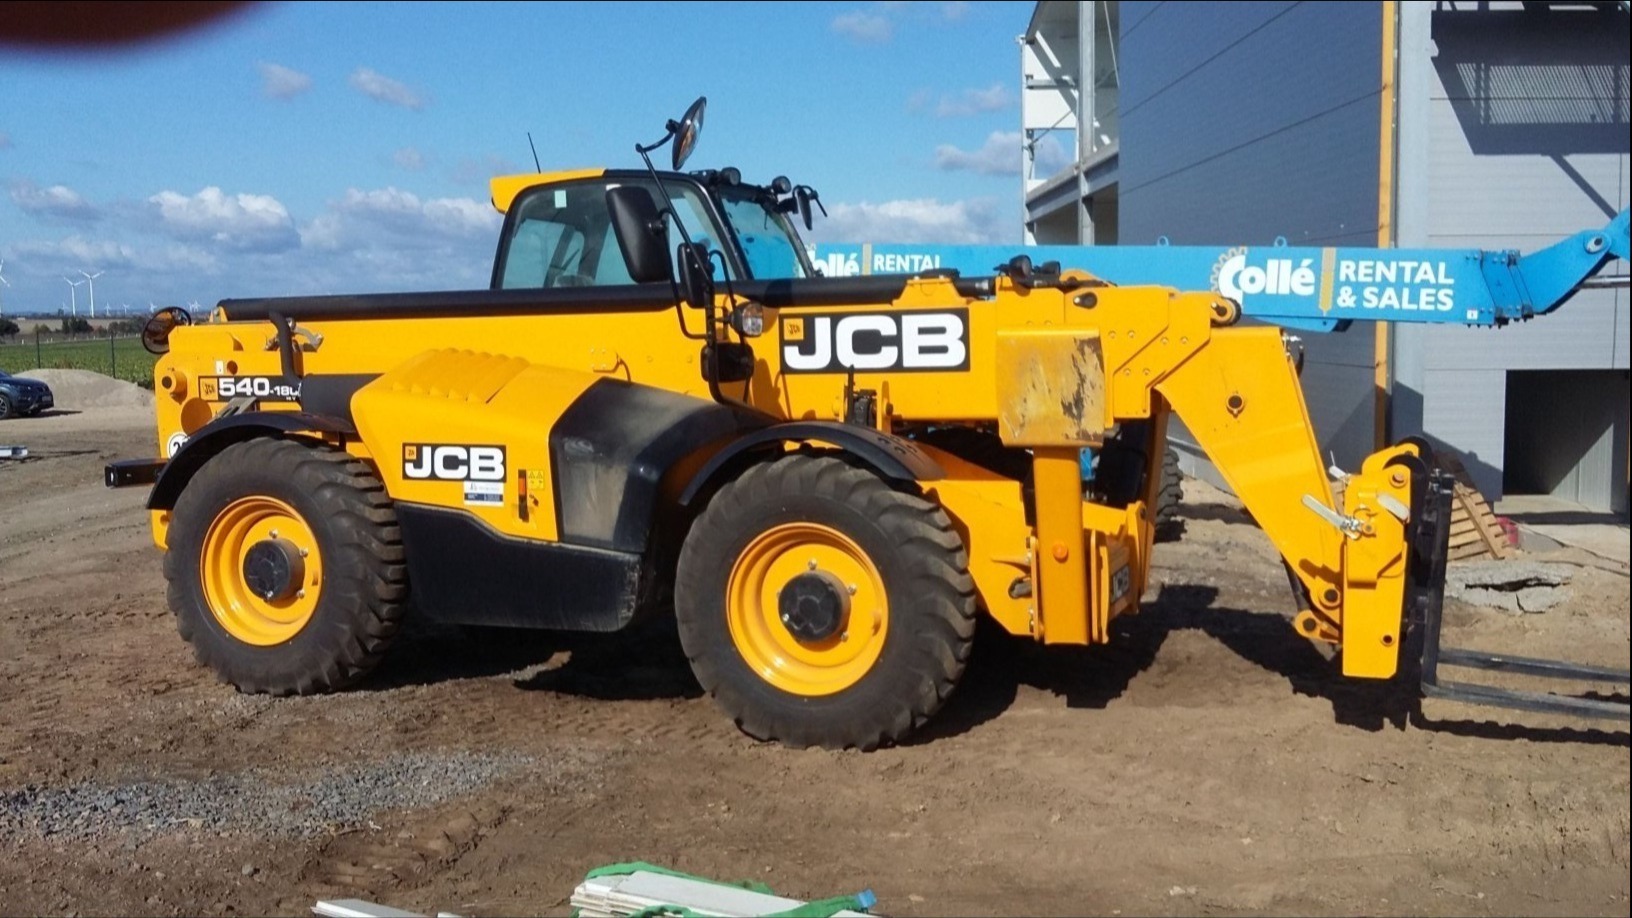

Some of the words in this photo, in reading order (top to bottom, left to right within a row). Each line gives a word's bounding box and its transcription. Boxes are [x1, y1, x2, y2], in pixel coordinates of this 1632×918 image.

[1218, 254, 1315, 309] Collé
[1339, 260, 1455, 285] RENTAL
[1336, 286, 1356, 308] &
[1362, 286, 1455, 311] SALES
[783, 313, 967, 370] JCB
[404, 445, 505, 480] JCB
